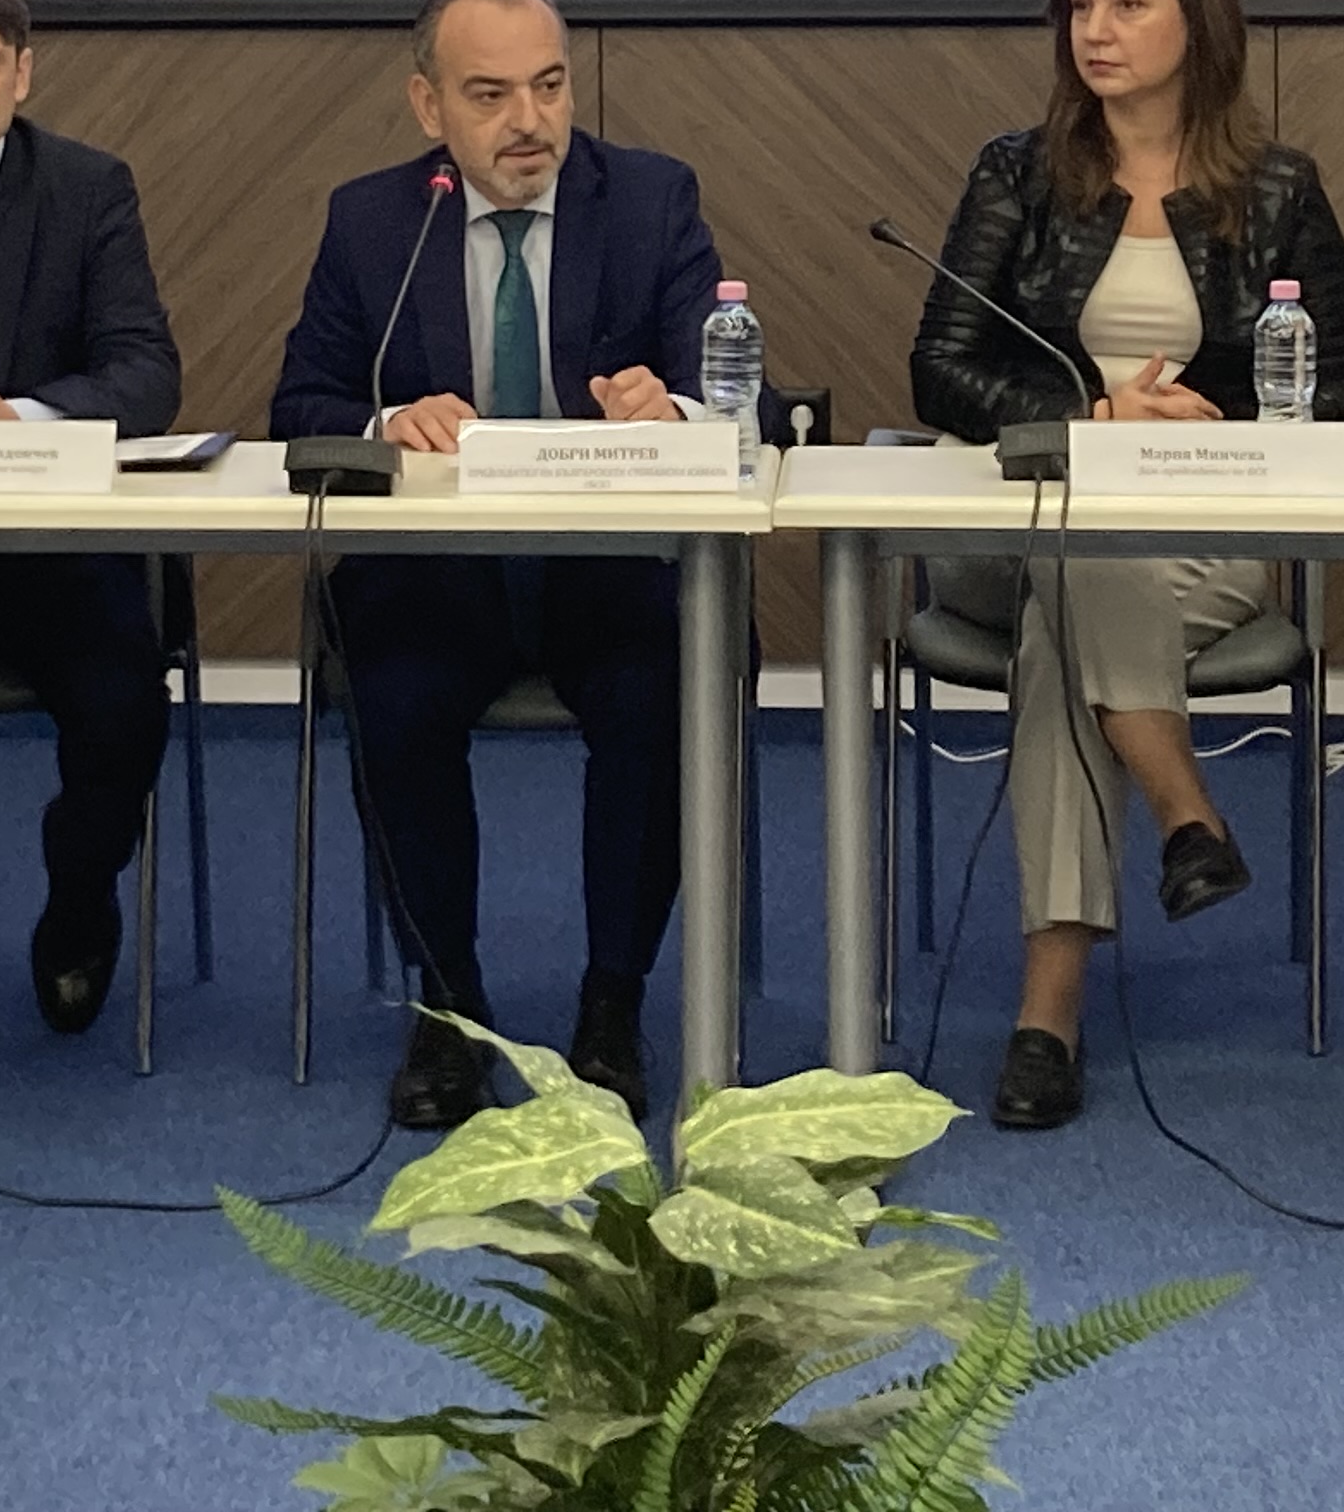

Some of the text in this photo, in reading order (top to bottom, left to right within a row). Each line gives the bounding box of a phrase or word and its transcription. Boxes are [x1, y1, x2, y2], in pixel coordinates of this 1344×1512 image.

[535, 447, 659, 462] ДОБРИ МИТРЕВ
[1140, 447, 1193, 464] Мария
